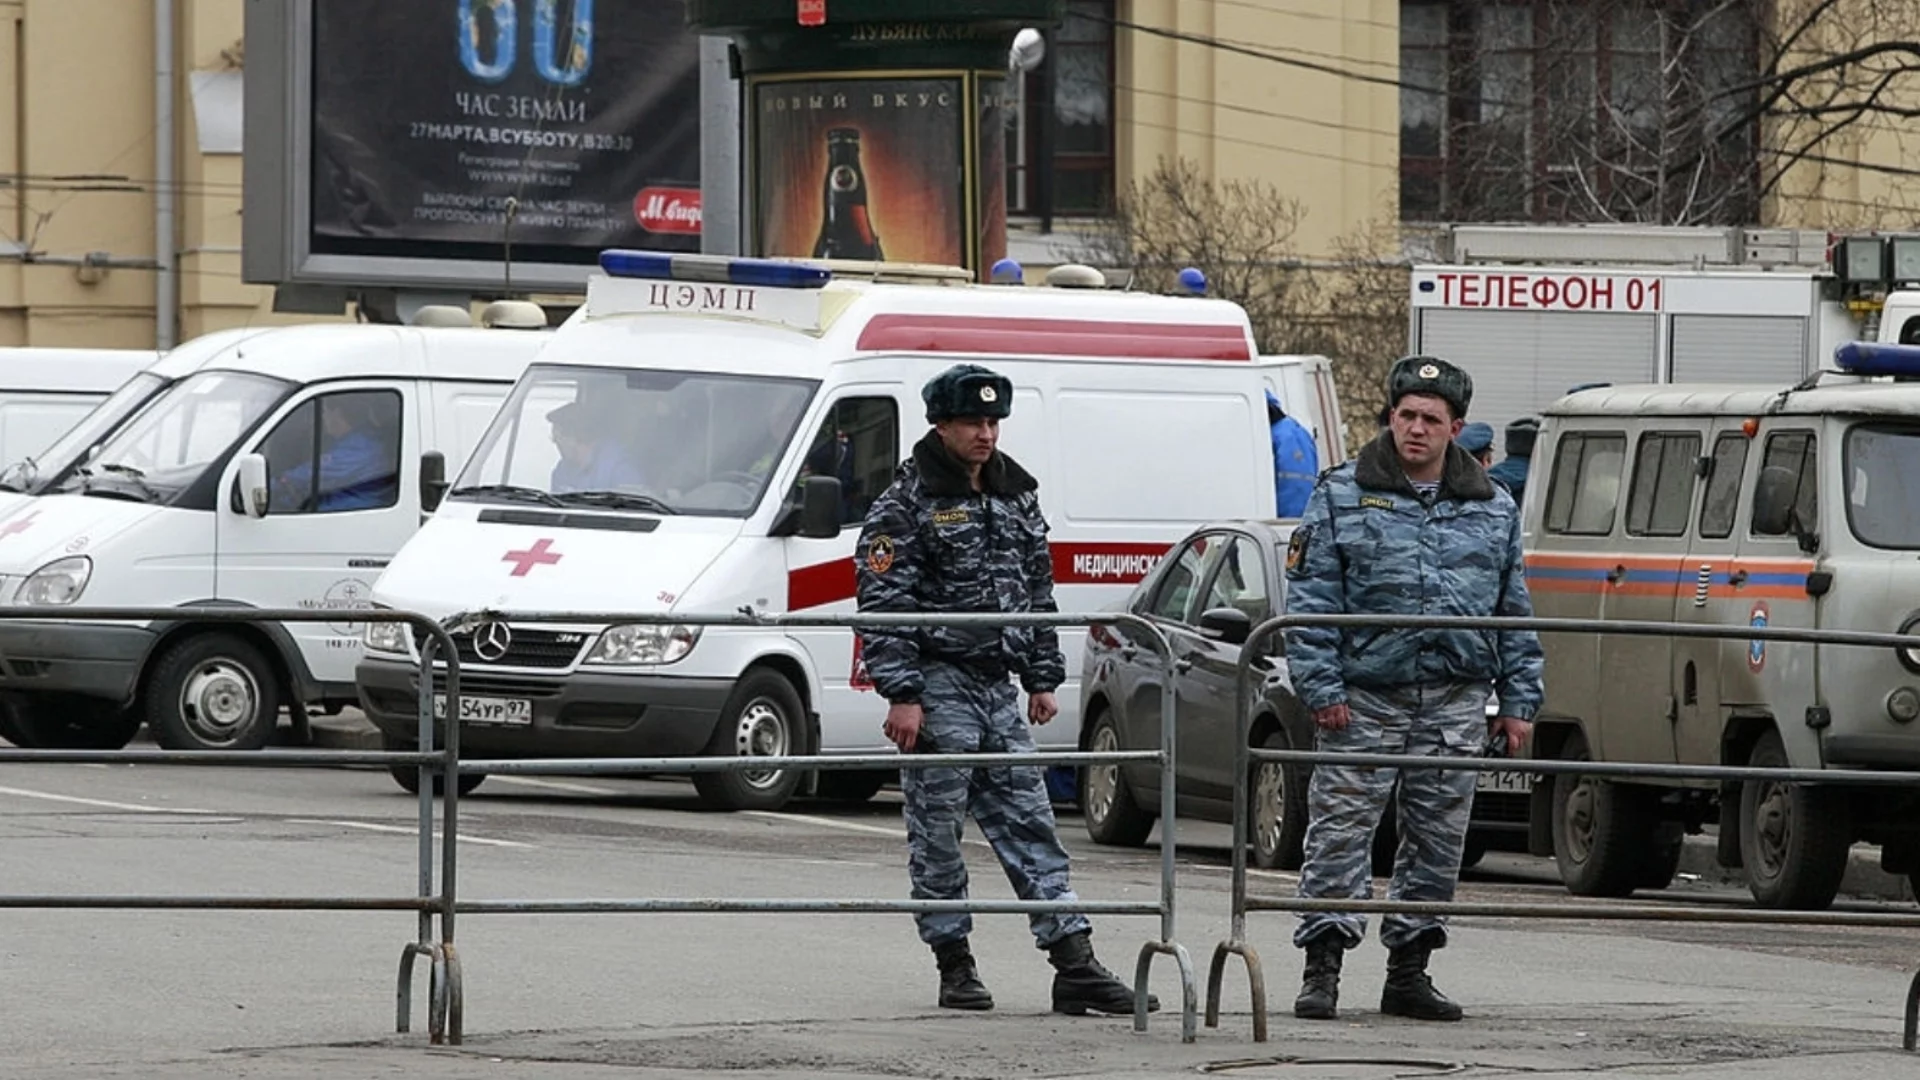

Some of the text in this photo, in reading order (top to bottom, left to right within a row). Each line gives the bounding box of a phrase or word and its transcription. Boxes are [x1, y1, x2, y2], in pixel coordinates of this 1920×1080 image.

[456, 92, 587, 123] ЧАС ЗЕМЛИ
[873, 92, 950, 108] ВКУС
[650, 284, 756, 311] ЦЭМП
[1437, 274, 1662, 311] ТЕЛЕФОН 01
[440, 699, 504, 719] У54УР
